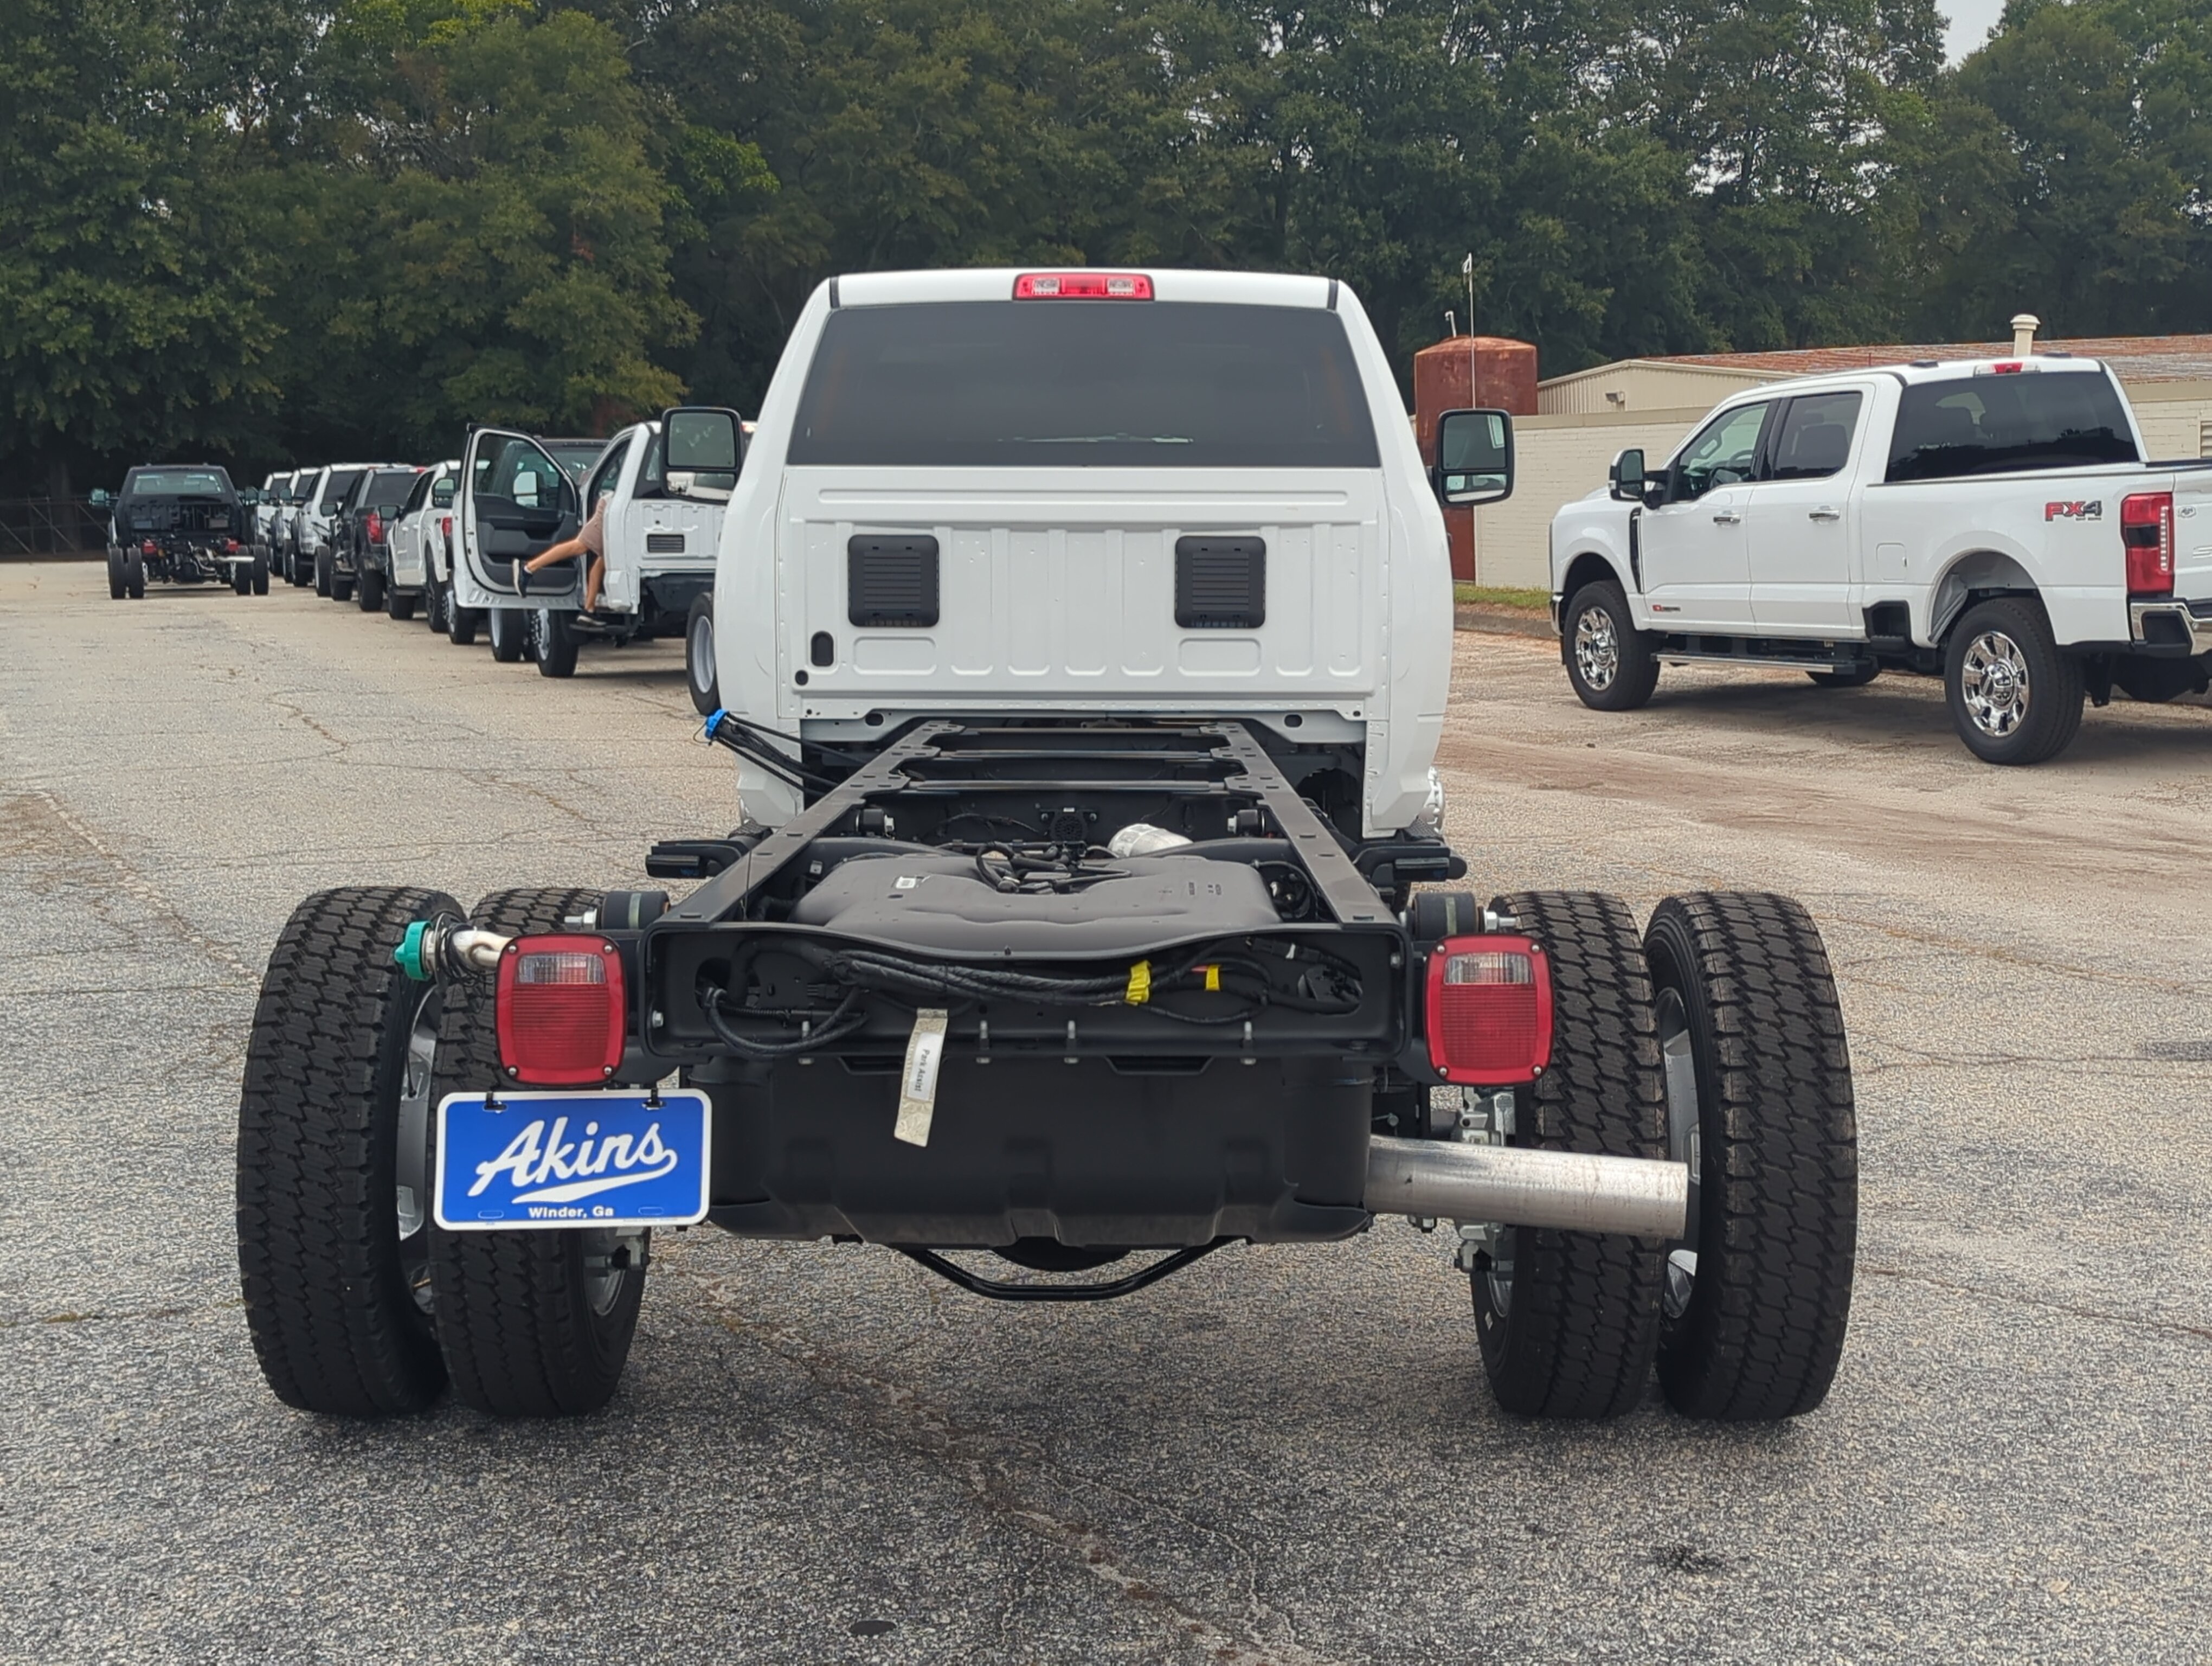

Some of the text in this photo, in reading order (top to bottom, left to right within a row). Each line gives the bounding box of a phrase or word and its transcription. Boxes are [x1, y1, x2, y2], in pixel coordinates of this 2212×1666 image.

[2044, 500, 2102, 522] FX4
[920, 1048, 930, 1067] Park
[467, 1116, 672, 1197] Akins
[528, 1205, 614, 1219] Winder, Ga
